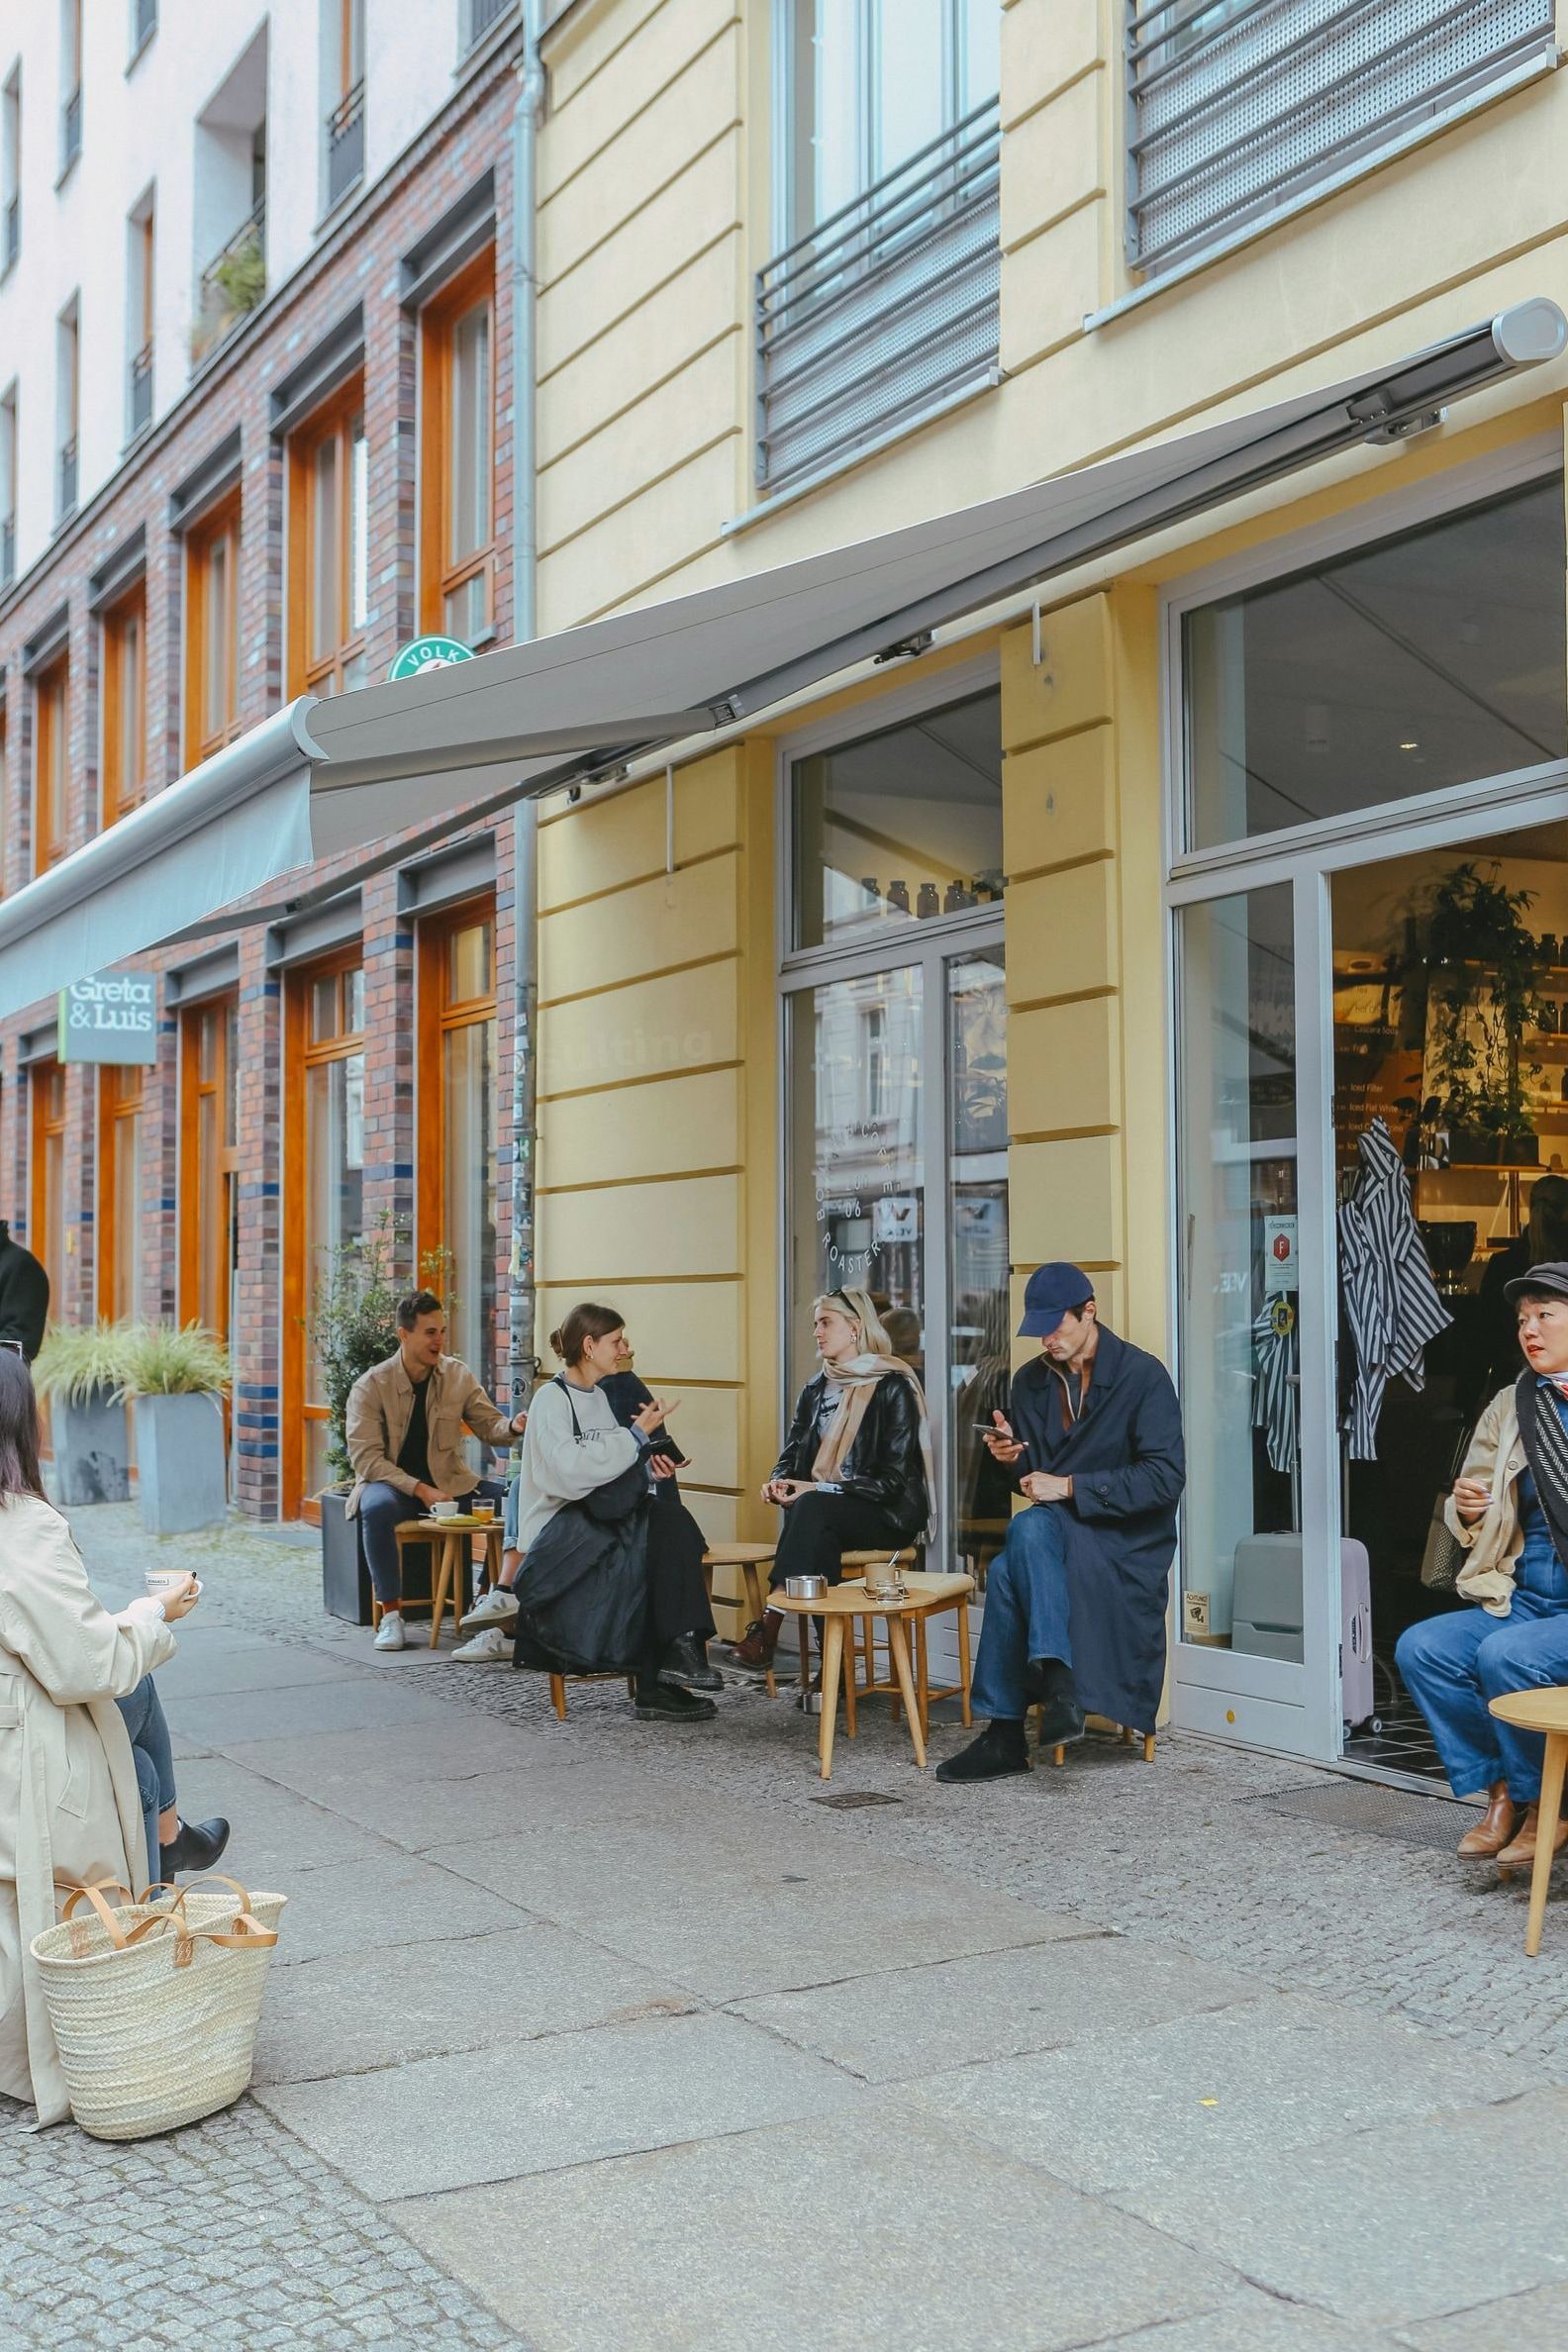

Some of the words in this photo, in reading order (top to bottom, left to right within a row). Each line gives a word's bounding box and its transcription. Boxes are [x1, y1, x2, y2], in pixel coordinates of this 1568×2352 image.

[406, 645, 459, 667] VOLK
[69, 976, 151, 1004] Greta
[69, 1002, 91, 1029] &
[93, 1003, 151, 1031] Luis
